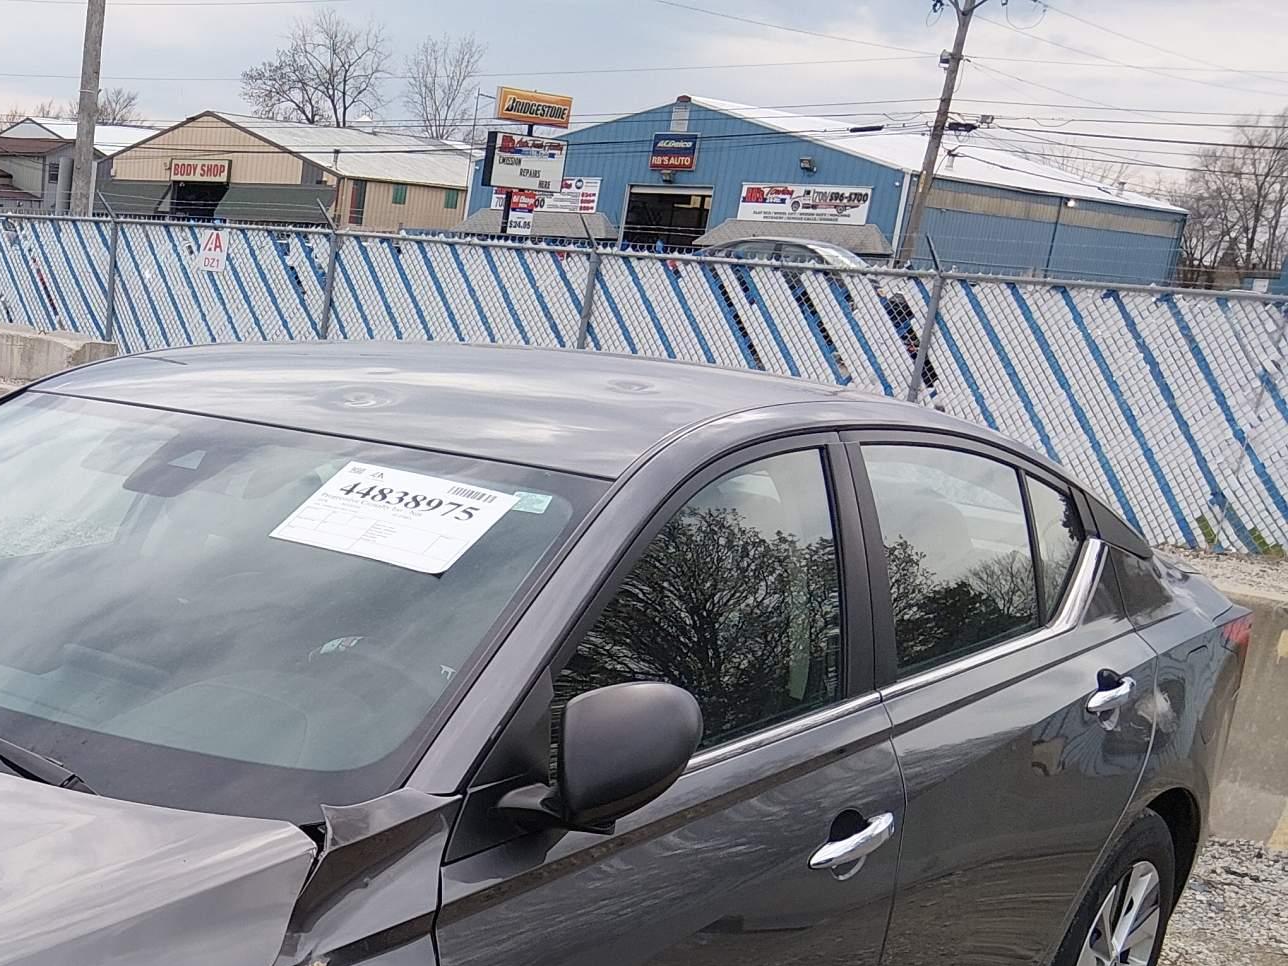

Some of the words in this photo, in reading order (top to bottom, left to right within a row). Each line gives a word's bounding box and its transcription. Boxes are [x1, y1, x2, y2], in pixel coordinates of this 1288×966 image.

[504, 97, 568, 120] BRIDGESTONE
[669, 156, 691, 166] AUTO
[173, 163, 198, 177] BODY
[199, 163, 226, 177] SHOP
[519, 168, 541, 178] REPAIRS
[537, 180, 551, 189] HERE
[203, 257, 220, 269] DZ1
[339, 481, 481, 522] 44838975
